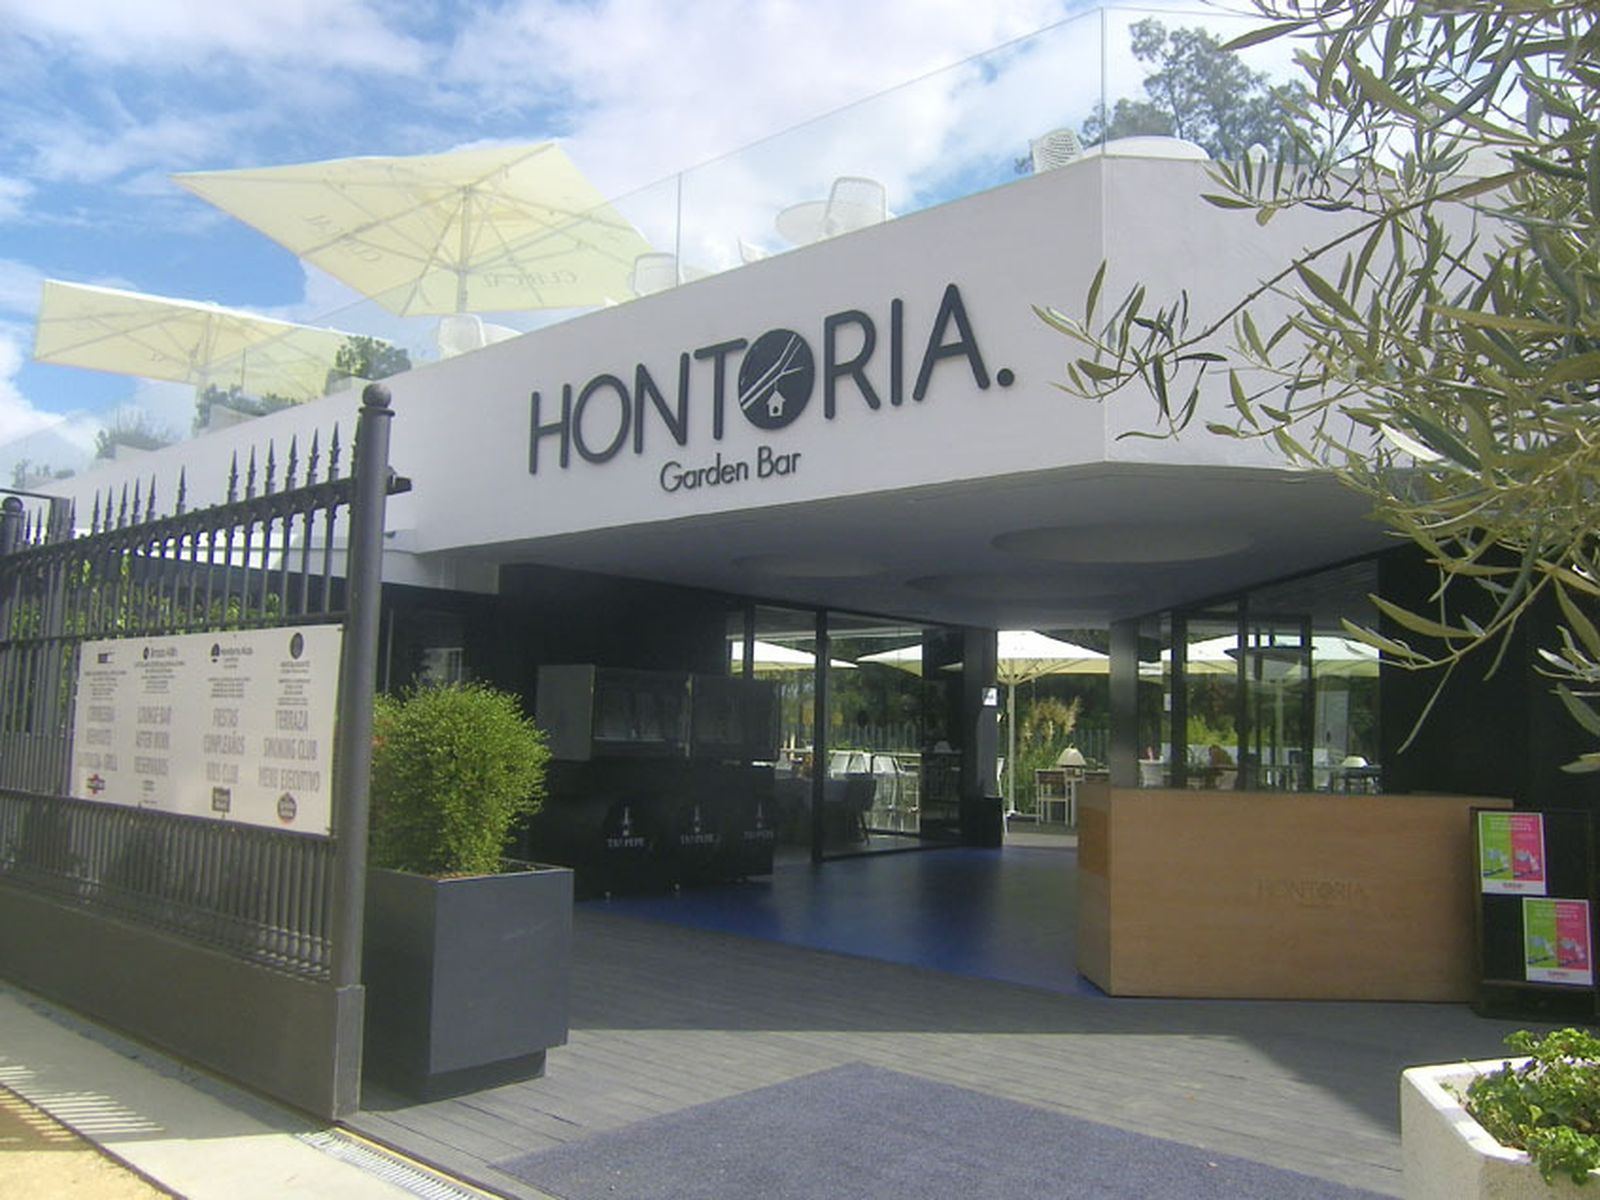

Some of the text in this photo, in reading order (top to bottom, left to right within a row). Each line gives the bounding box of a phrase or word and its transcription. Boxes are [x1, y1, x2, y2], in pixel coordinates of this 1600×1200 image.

[660, 446, 802, 492] Garden Bar
[275, 709, 309, 731] TERRAZA
